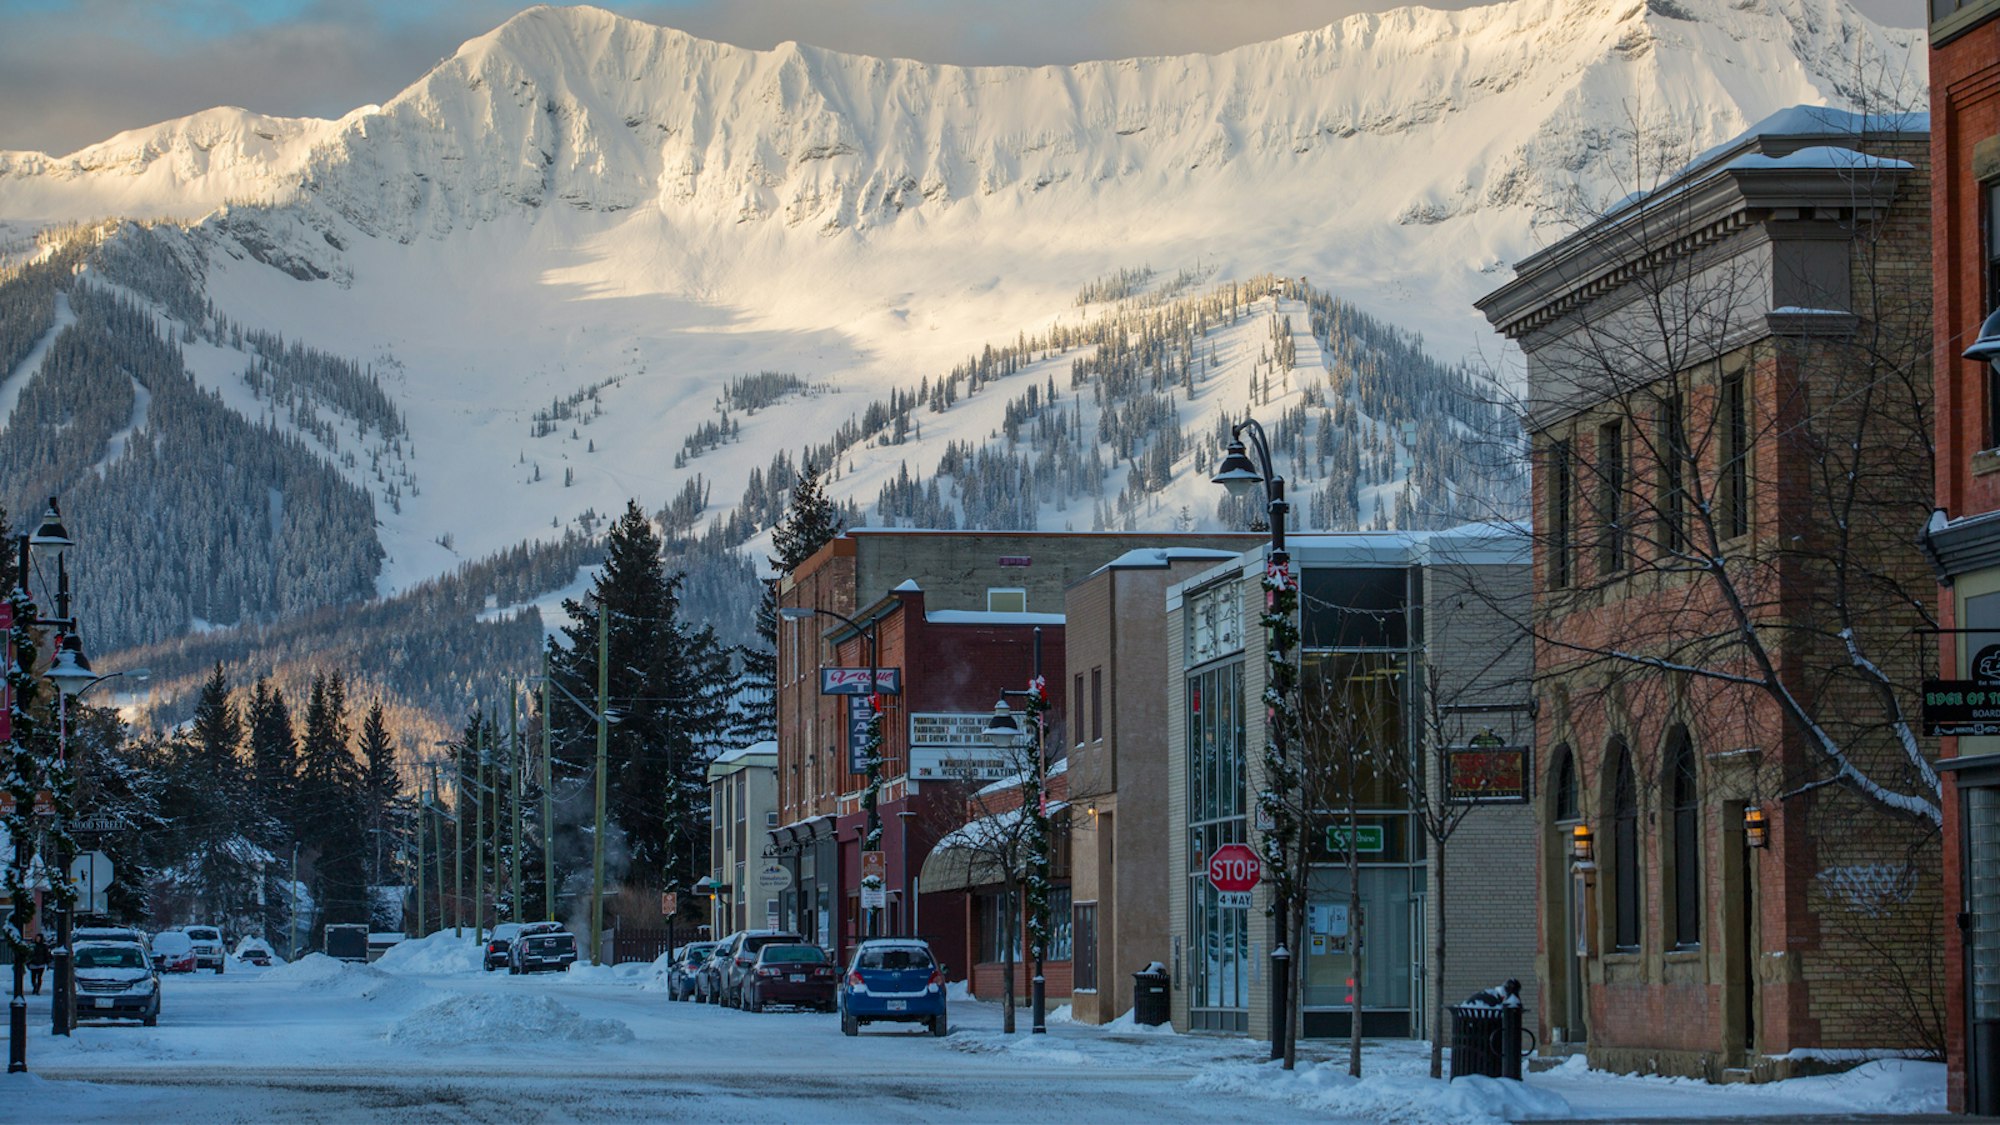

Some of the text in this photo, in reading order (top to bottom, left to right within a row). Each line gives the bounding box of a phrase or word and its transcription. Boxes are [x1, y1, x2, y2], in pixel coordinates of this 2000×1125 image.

[831, 669, 894, 684] Voue
[1926, 692, 1963, 706] EDGE
[1966, 692, 1985, 706] OF
[852, 682, 872, 770] THEATRE
[914, 717, 937, 725] PHANTOM
[938, 717, 958, 725] THREAD
[914, 726, 945, 734] PADDINGTON
[915, 734, 928, 743] LATE
[928, 734, 948, 743] SHOWS
[949, 734, 962, 743] ONLY
[941, 767, 979, 777] WEEKEND
[71, 819, 124, 830] WOOD STREET
[1211, 859, 1259, 881] STOP
[1219, 895, 1251, 905] 4-WAY
